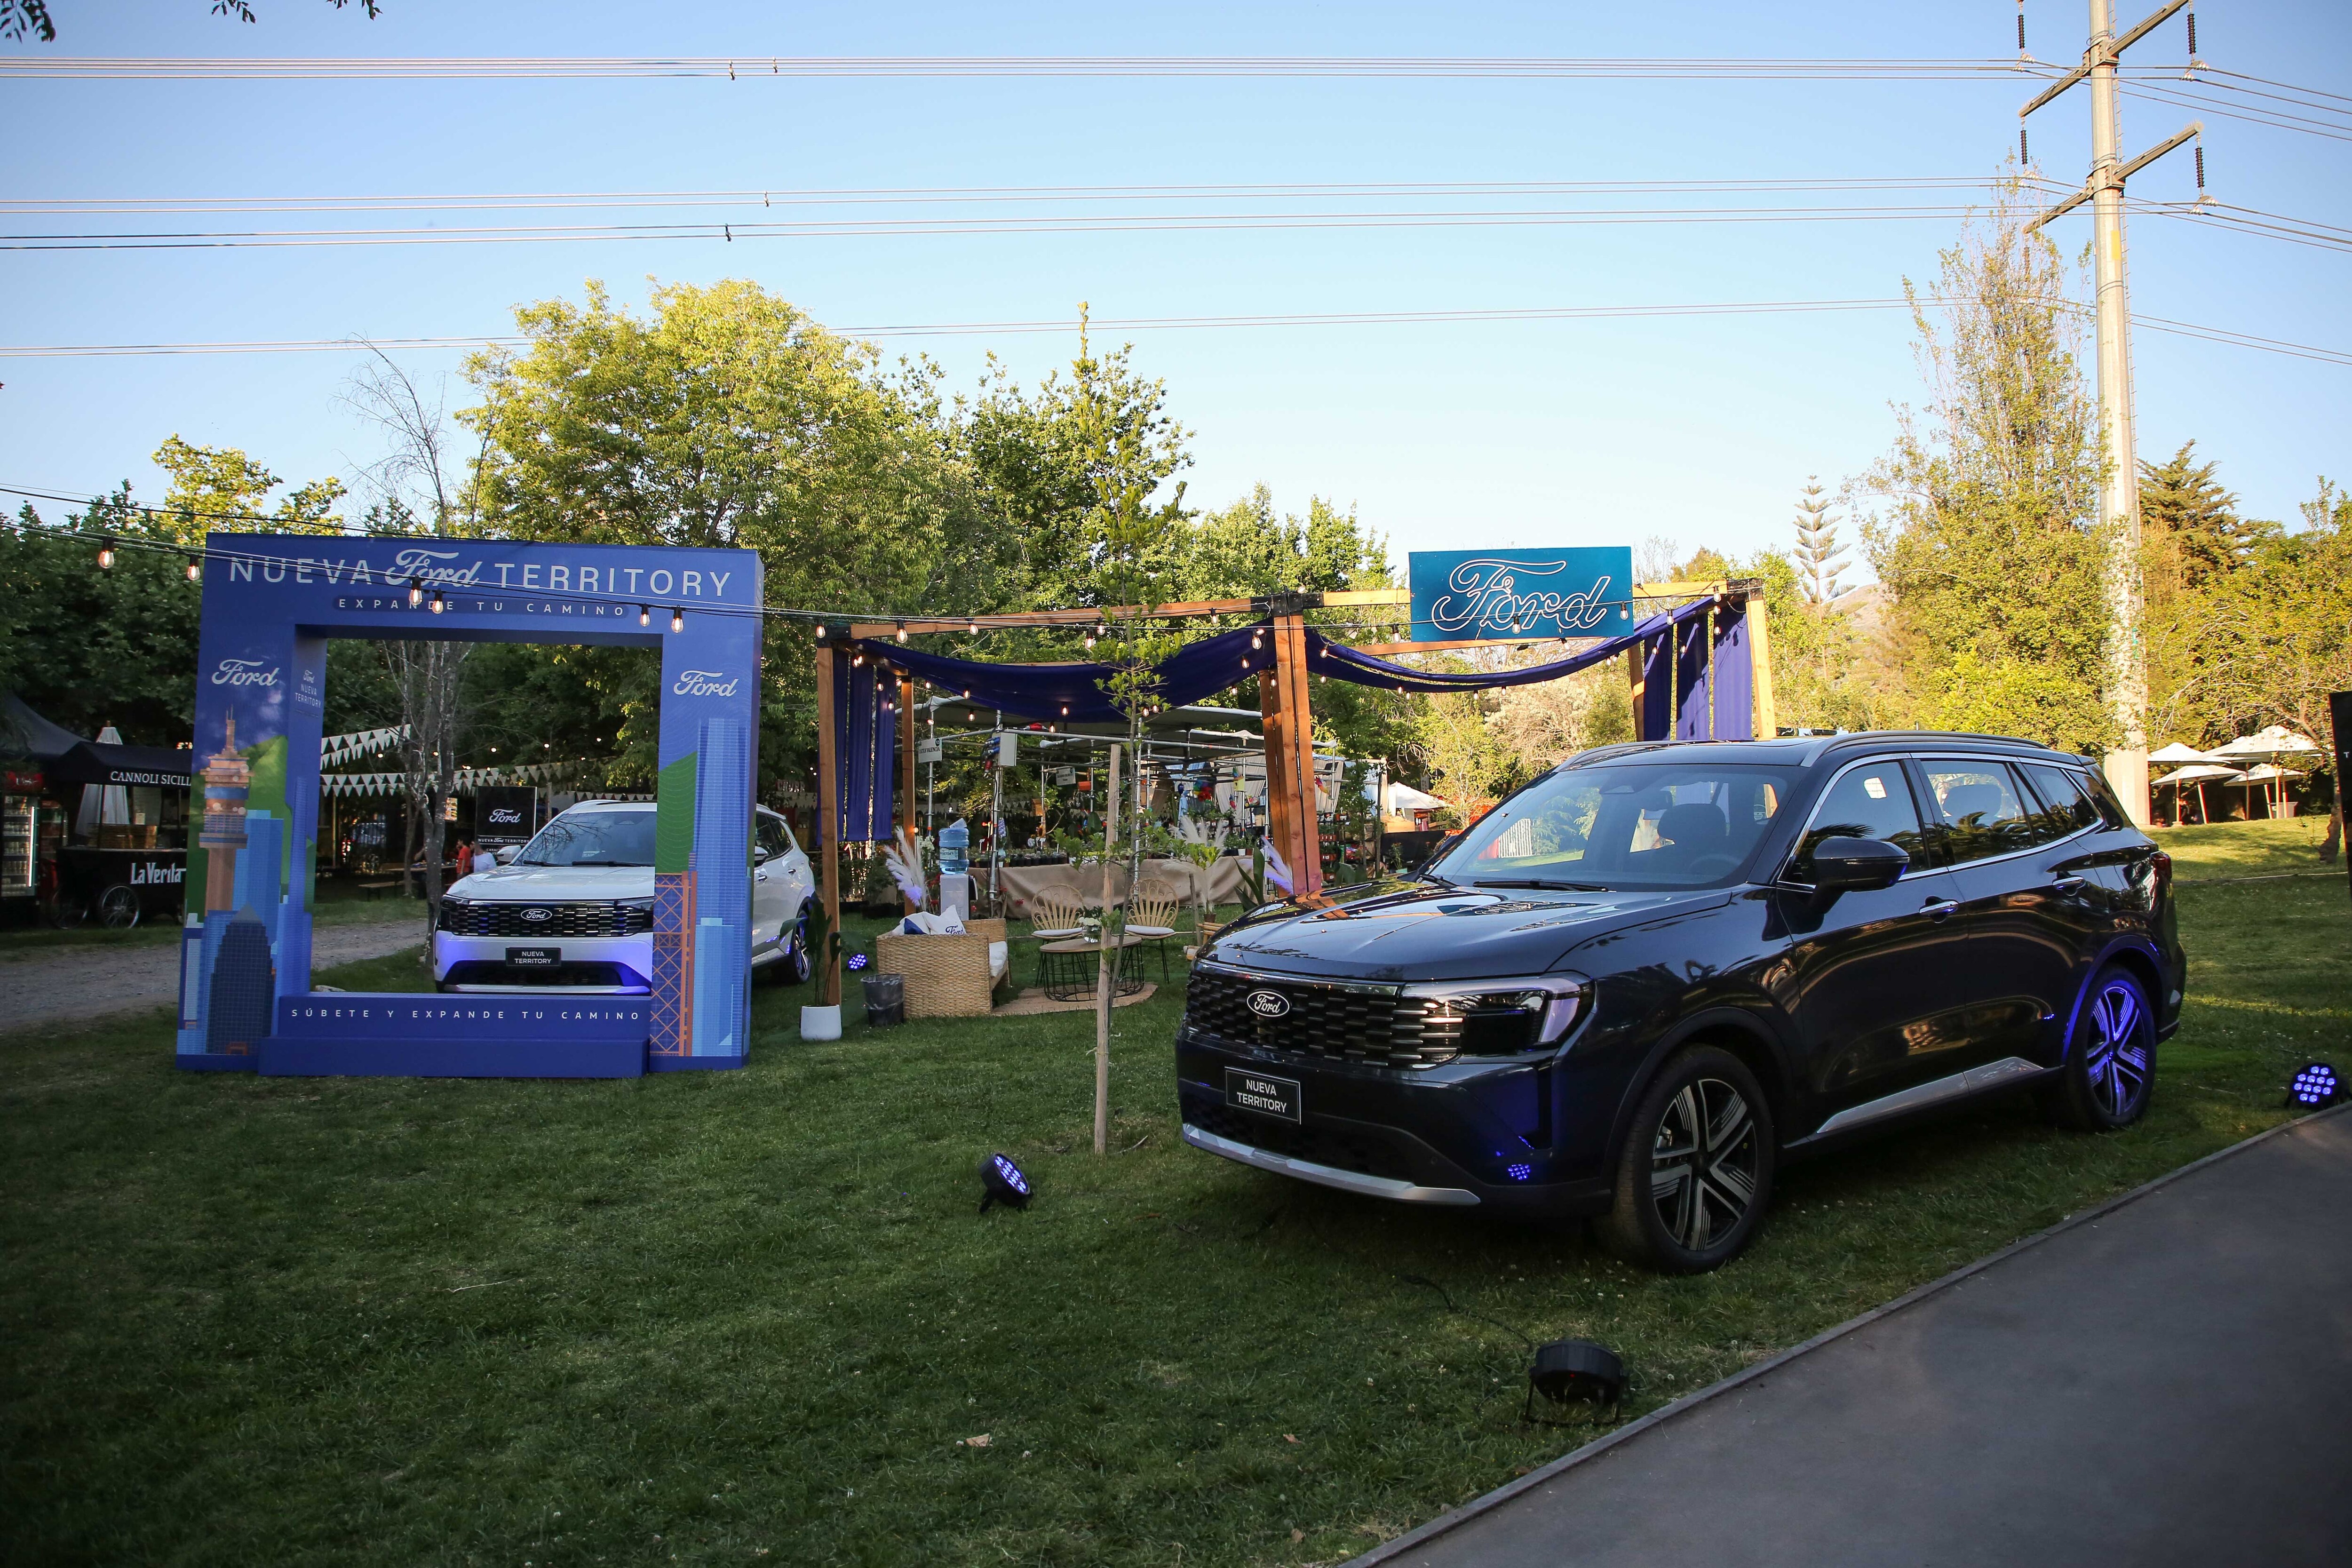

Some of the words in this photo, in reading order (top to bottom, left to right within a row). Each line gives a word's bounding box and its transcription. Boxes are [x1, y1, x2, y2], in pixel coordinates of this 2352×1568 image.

[230, 557, 372, 585] NUEVA
[385, 549, 482, 588] Ford
[494, 563, 731, 597] TERRITORY
[1431, 558, 1611, 631] Ford
[477, 602, 503, 611] TU
[526, 603, 624, 616] CAMINO
[212, 659, 279, 686] Ford
[303, 669, 315, 683] Ford
[301, 684, 317, 696] NUEVA
[673, 670, 739, 697] Ford
[294, 692, 322, 708] TERRITORY
[110, 771, 159, 784] CANNOLI
[489, 809, 521, 823] Ford
[526, 910, 546, 919] Ford
[1254, 994, 1281, 1013] Ford
[292, 1008, 369, 1017] SÚBETE
[1246, 1079, 1277, 1096] NUEVA
[1237, 1091, 1287, 1113] TERRITORY
